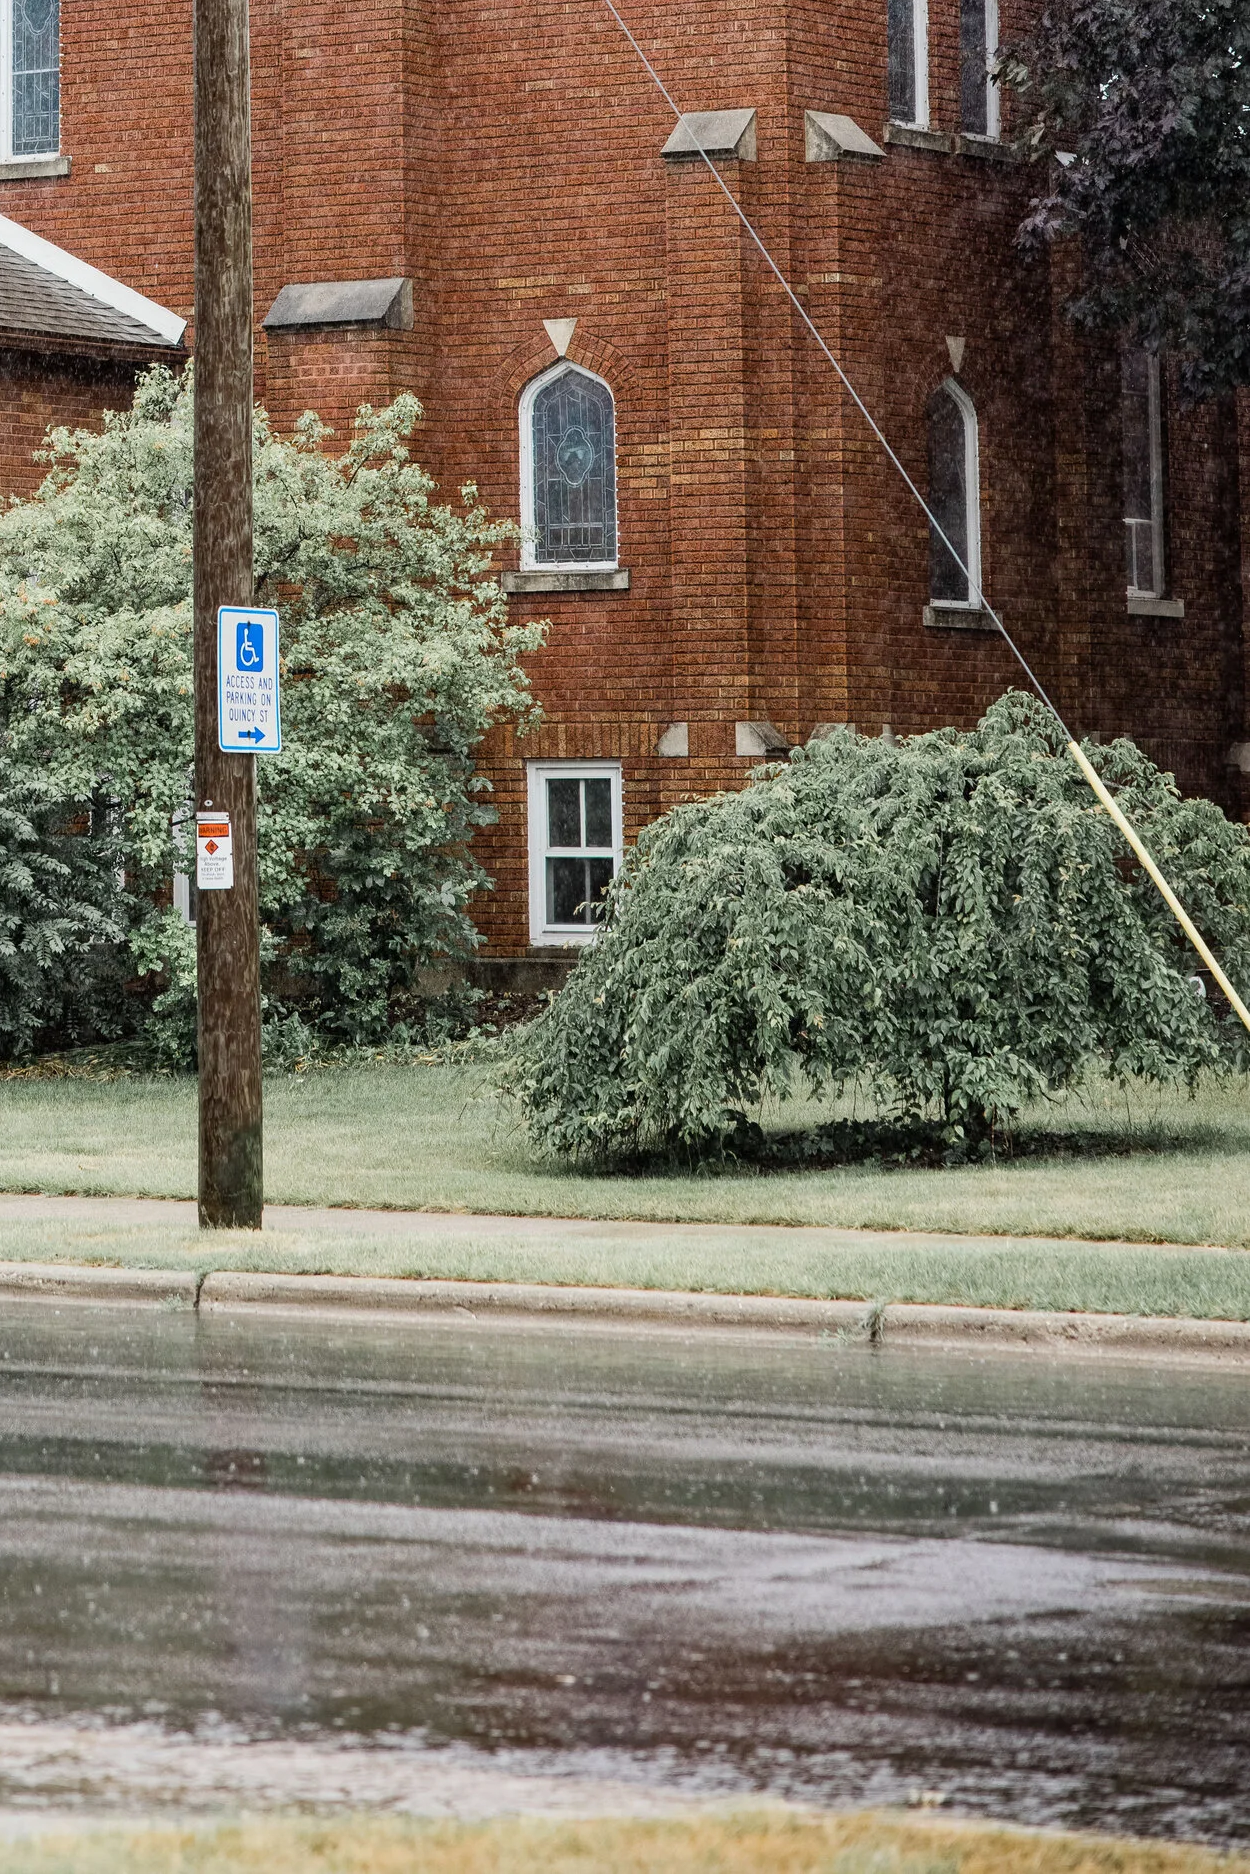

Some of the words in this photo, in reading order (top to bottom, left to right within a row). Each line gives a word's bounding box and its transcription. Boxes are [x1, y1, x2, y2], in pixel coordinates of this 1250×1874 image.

[226, 674, 255, 689] ACCESS
[258, 677, 273, 691] AND
[226, 691, 257, 706] PARKING
[261, 693, 272, 706] ON
[229, 708, 256, 722] QUINCY
[259, 709, 268, 723] ST
[198, 826, 227, 834] WARNING
